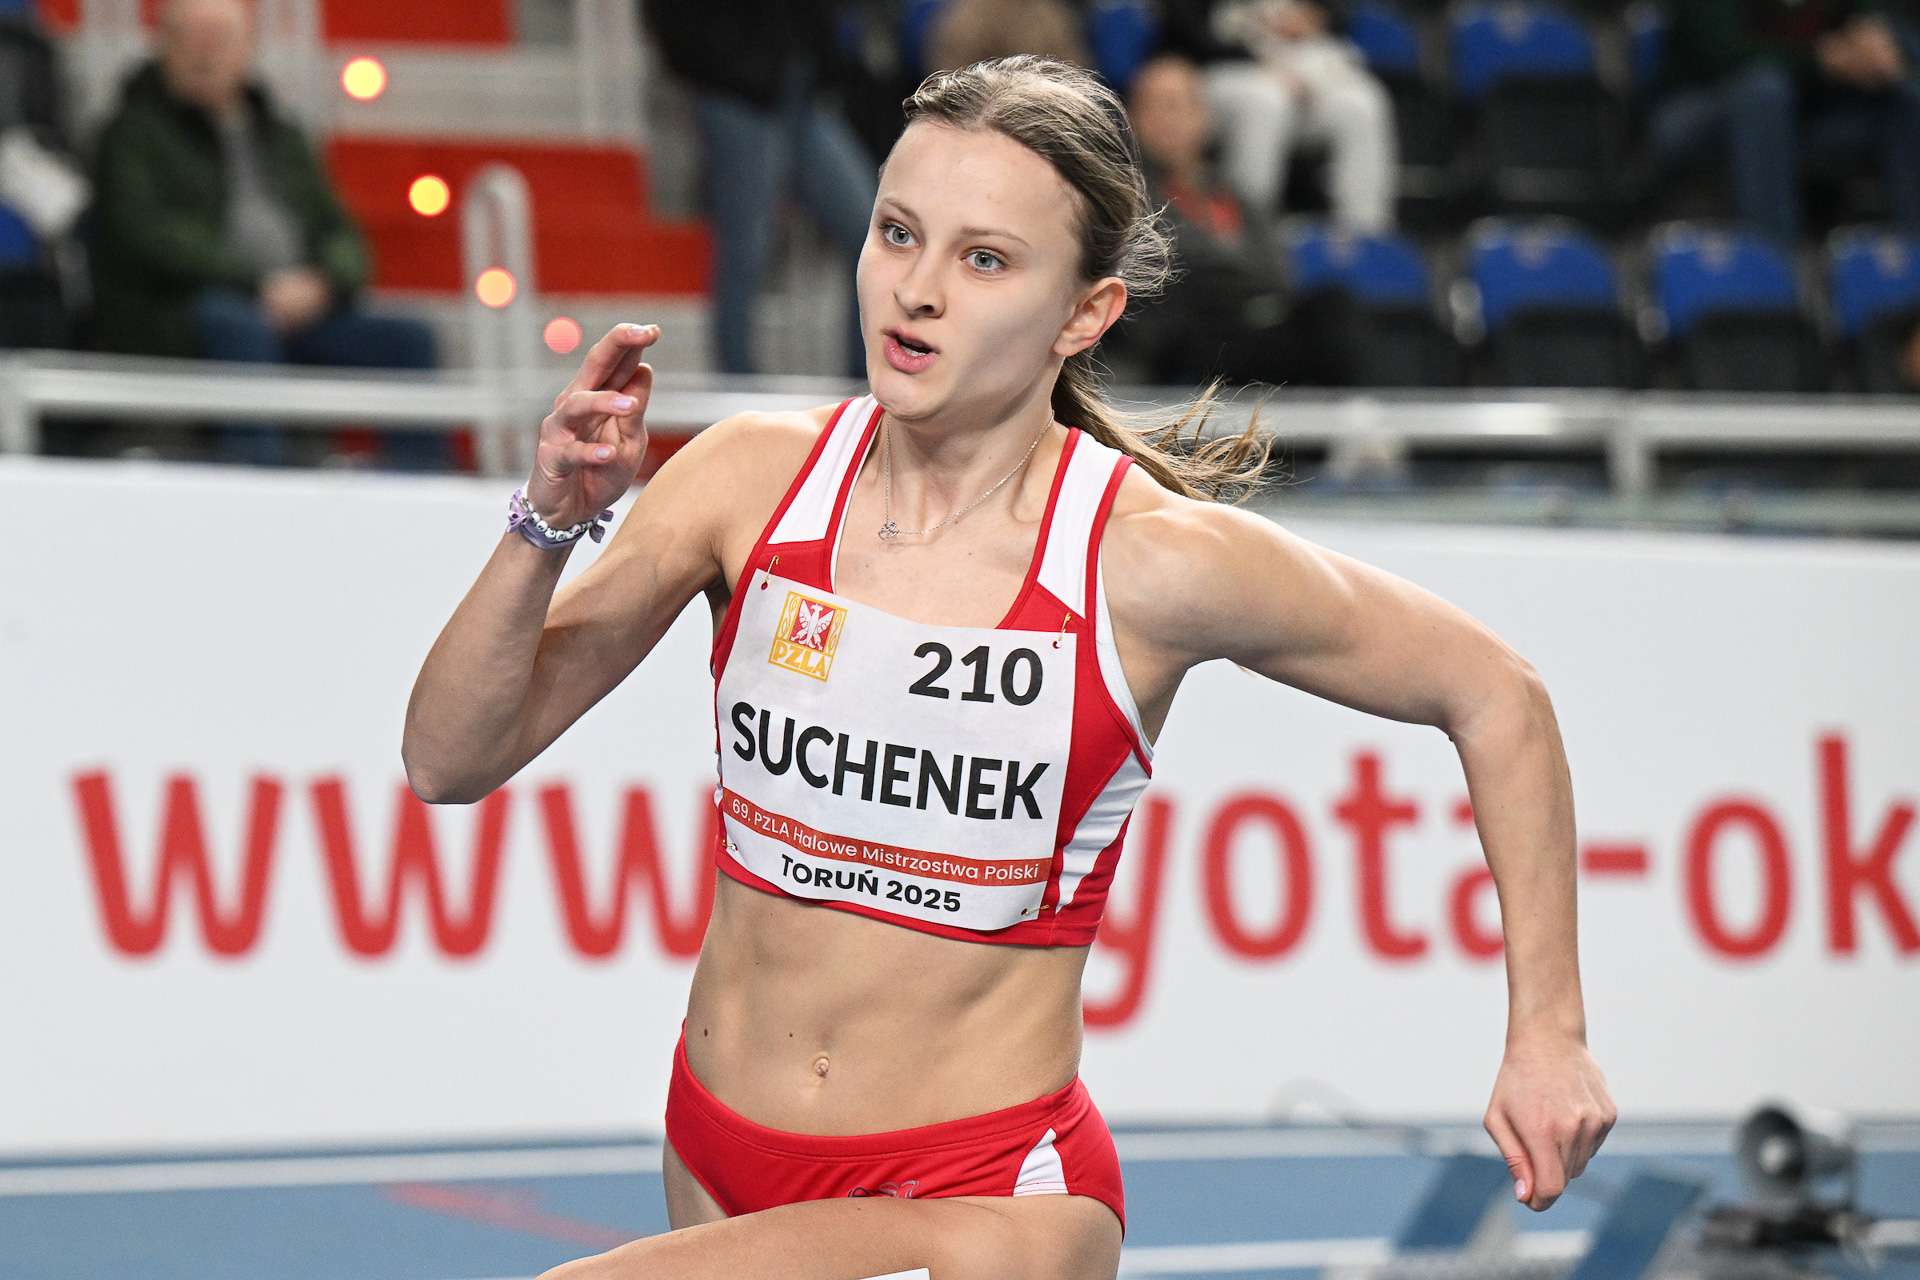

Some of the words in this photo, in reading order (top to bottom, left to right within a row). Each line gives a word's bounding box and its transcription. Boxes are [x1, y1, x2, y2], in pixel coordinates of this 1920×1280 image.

[772, 643, 827, 678] PZLA
[908, 641, 1044, 707] 210
[731, 701, 1051, 820] SUCHENEK
[732, 798, 751, 822] 69.
[754, 811, 790, 838] PZLA
[793, 826, 858, 857] Halowe
[862, 845, 979, 879] Mistrzostwa
[984, 863, 1039, 880] Polski
[781, 853, 879, 896] TORUŃ
[885, 880, 961, 912] 2025
